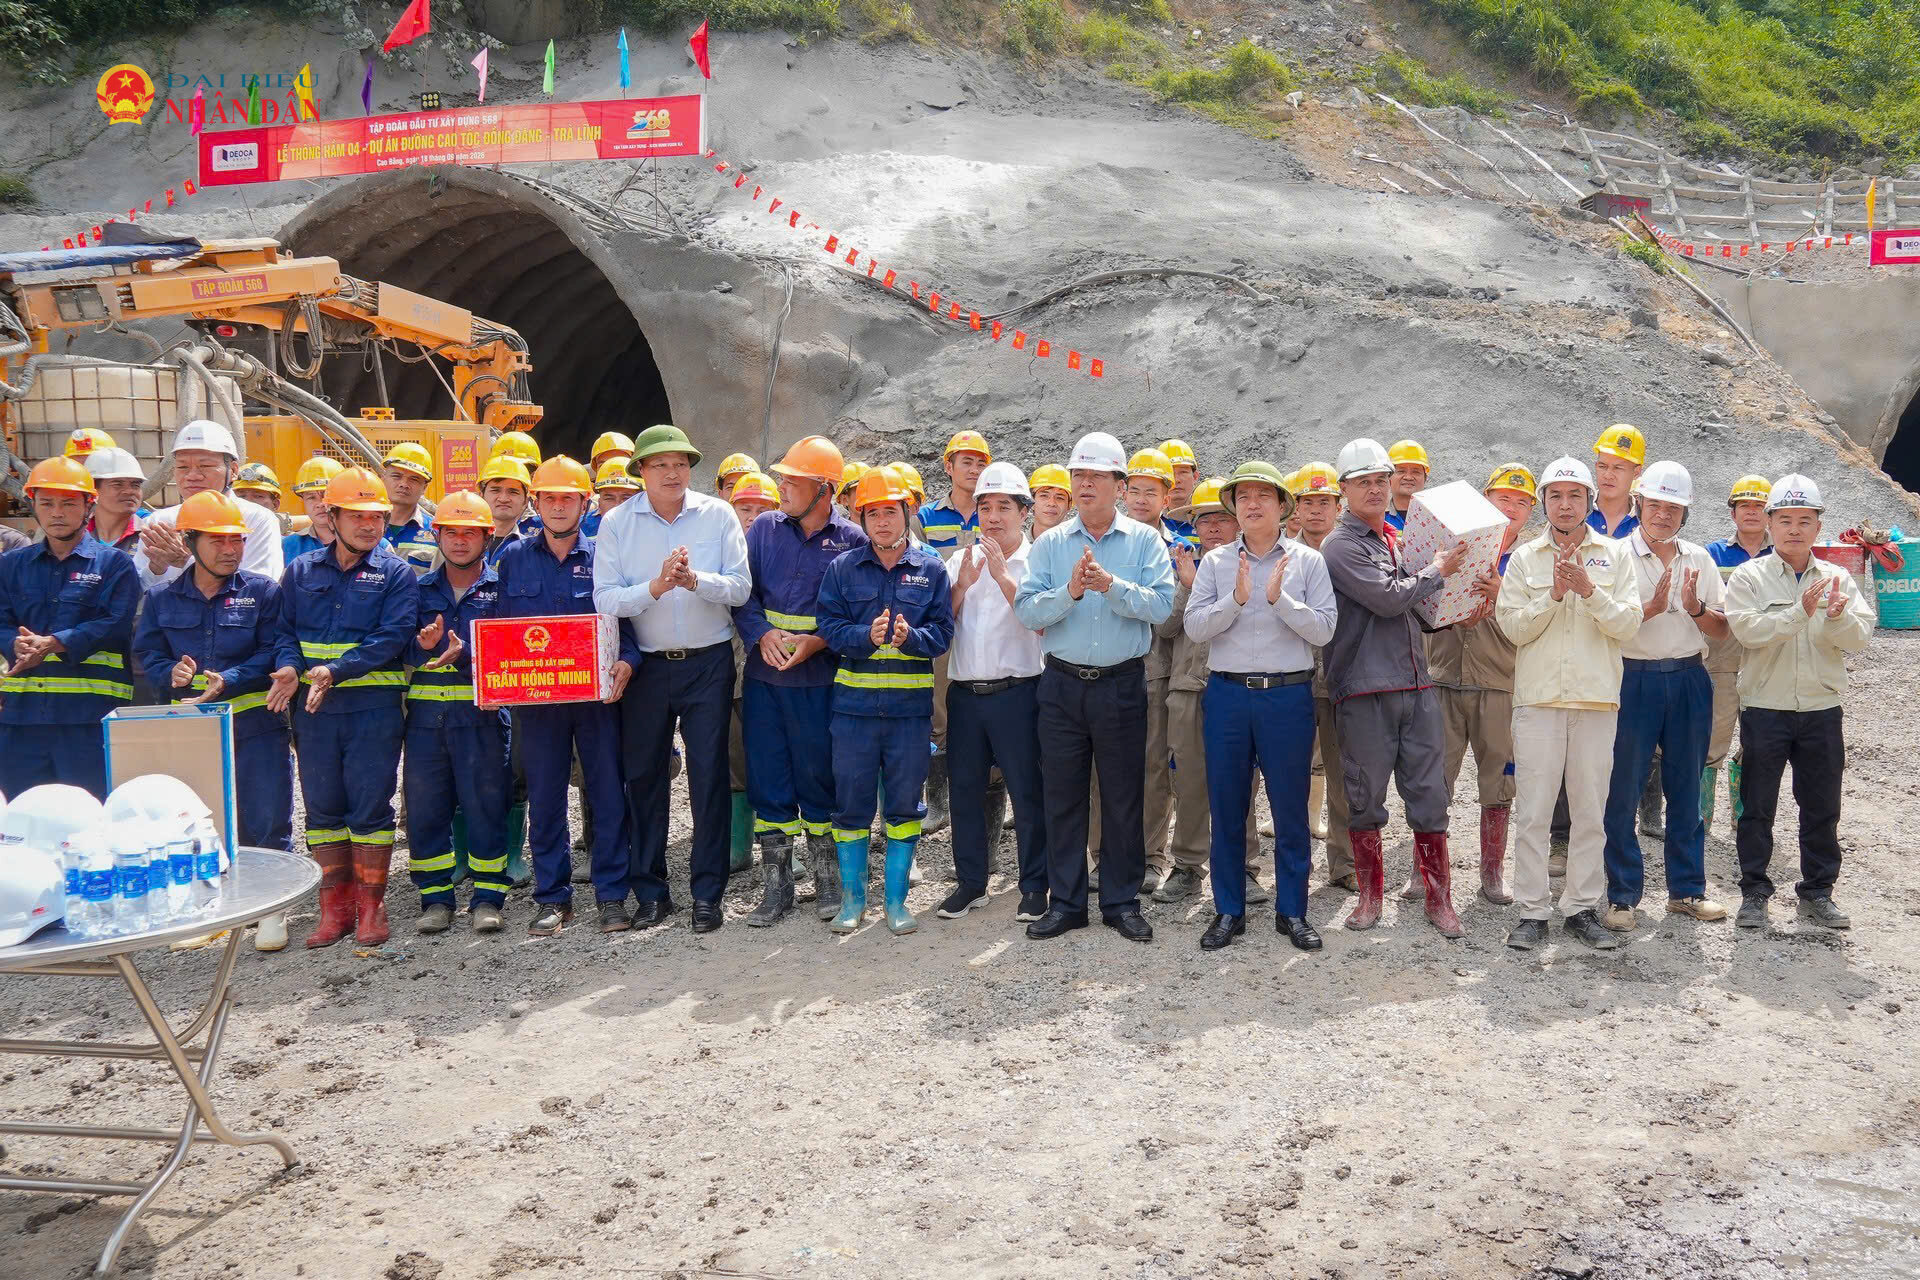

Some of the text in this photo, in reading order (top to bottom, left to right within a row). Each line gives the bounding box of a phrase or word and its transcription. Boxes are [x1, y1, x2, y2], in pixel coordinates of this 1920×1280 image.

[369, 115, 498, 135] TẬP ĐOÀN ĐẦU TƯ XÂY DỰNG 568
[628, 109, 671, 131] 568
[277, 143, 289, 163] LỄ
[289, 144, 321, 161] THÔNG
[323, 139, 345, 159] HẦM
[347, 141, 360, 157] 04
[369, 137, 384, 157] DỰ
[385, 134, 398, 152] ÁN
[401, 132, 435, 151] ĐƯỜNG
[437, 132, 458, 148] CAO
[483, 125, 512, 145] ĐỒNG
[553, 123, 574, 142] TRÀ
[577, 123, 602, 141] LĨNH
[196, 278, 263, 297] TẬP ĐOÀN 568
[449, 445, 473, 462] 568
[1875, 578, 1920, 593] OBELC
[535, 658, 544, 669] BỘ
[545, 657, 557, 667] XÂY
[486, 668, 591, 689] TRẦN HỒNG MINH
[526, 687, 551, 699] Tặng
